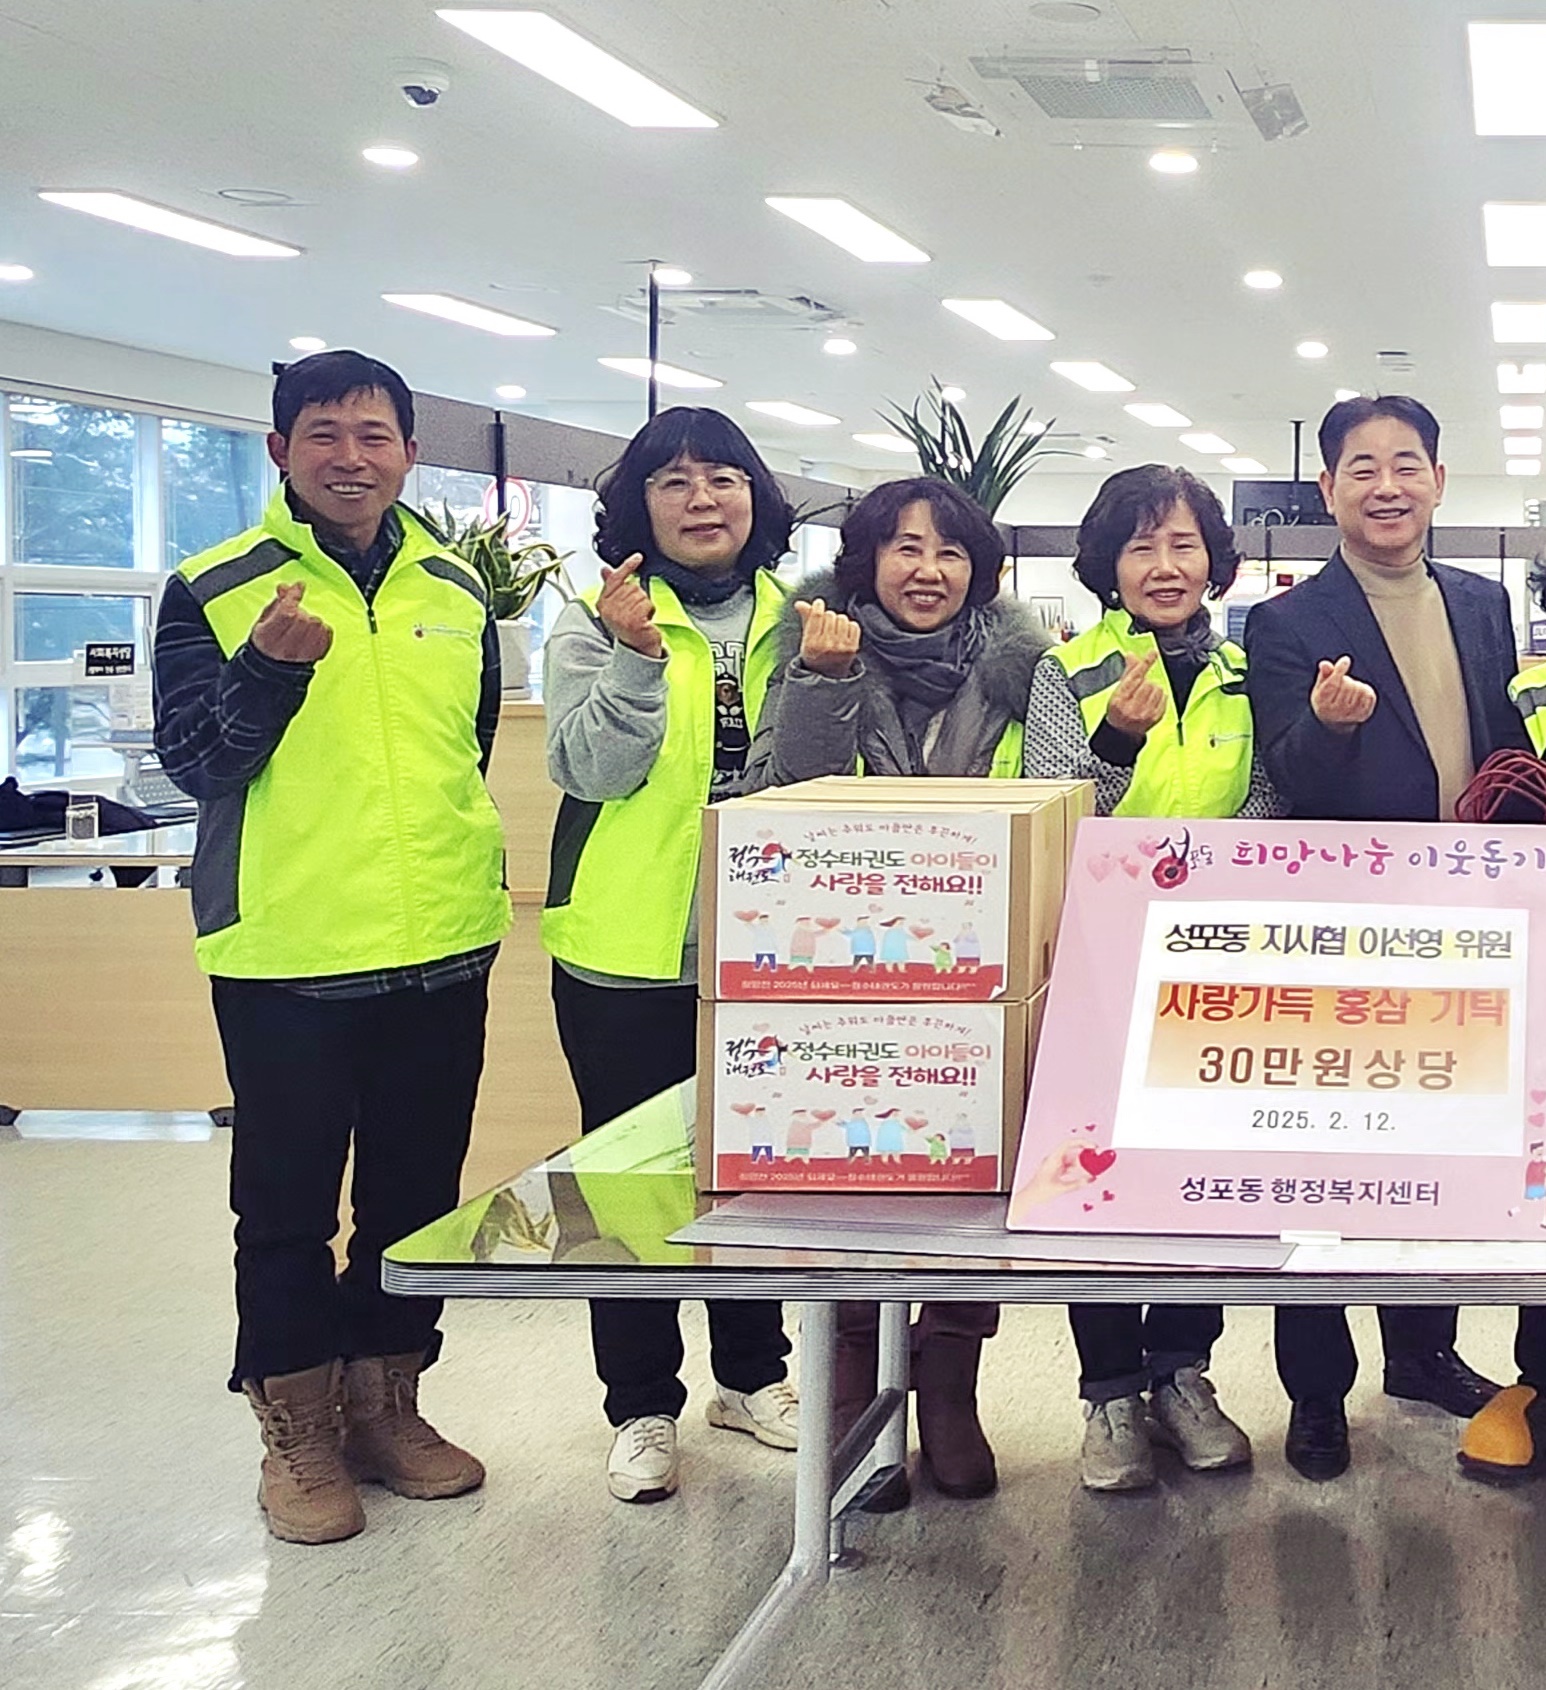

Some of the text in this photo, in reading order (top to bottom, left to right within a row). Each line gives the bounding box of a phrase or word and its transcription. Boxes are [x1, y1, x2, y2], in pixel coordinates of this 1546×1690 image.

[797, 849, 998, 872] 정수태권도 아이들이
[1231, 838, 1395, 876] 희망나눔
[1408, 839, 1546, 880] 이웃돕기
[810, 872, 984, 896] 사랑을 전해요!!
[1165, 924, 1250, 953] 성포동
[1360, 927, 1442, 959] 이선영
[1454, 929, 1513, 960] 위원
[1159, 984, 1508, 1027] 사랑가득 홍삼 기탁
[792, 1041, 992, 1063] 정수태권도 아이들이
[805, 1064, 978, 1088] 사랑을 전해요!!
[1252, 1109, 1397, 1132] 2025. 2. 12.
[1180, 1176, 1441, 1207] 성포동 행정복지센터
